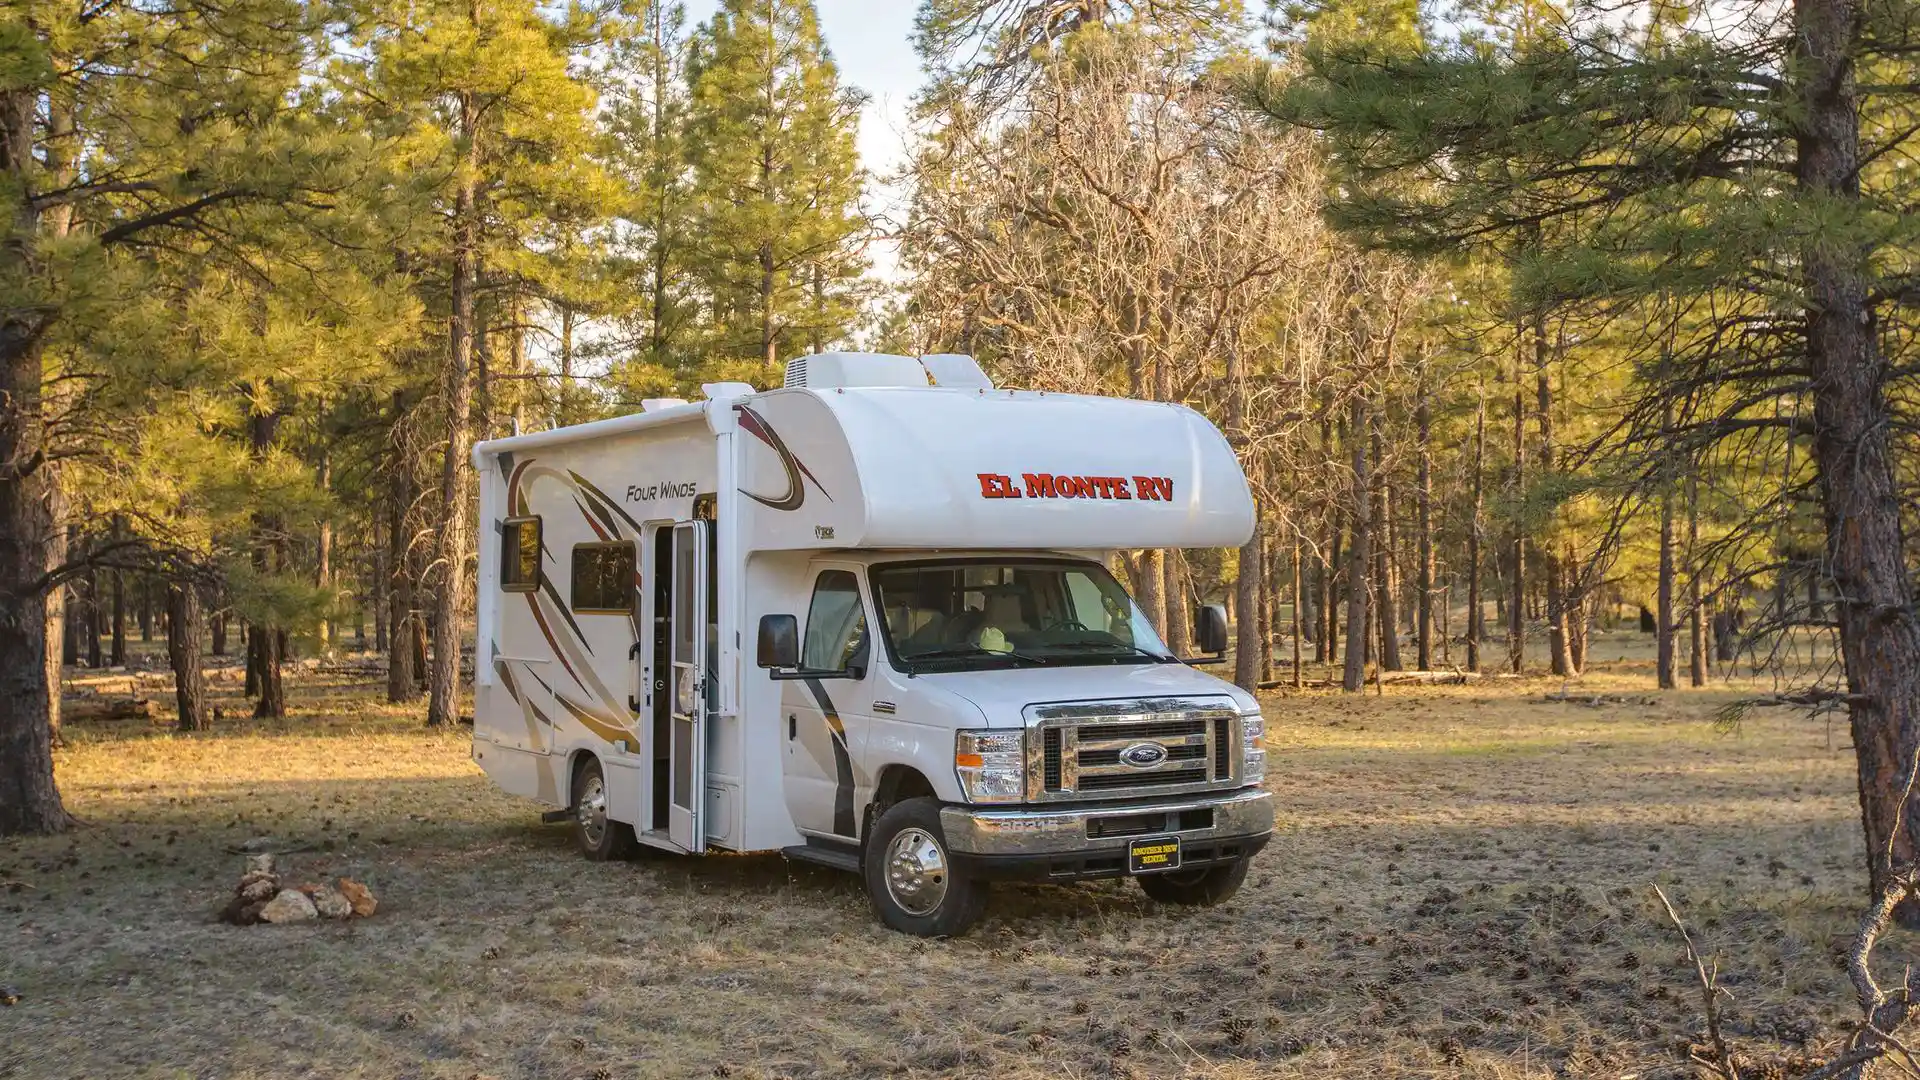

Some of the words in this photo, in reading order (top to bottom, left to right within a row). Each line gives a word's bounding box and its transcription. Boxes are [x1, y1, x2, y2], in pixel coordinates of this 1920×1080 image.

[1132, 476, 1174, 502] RV
[1132, 845, 1163, 856] ANOTHER
[1163, 844, 1178, 853] NEW
[1142, 854, 1168, 864] RENTAL
